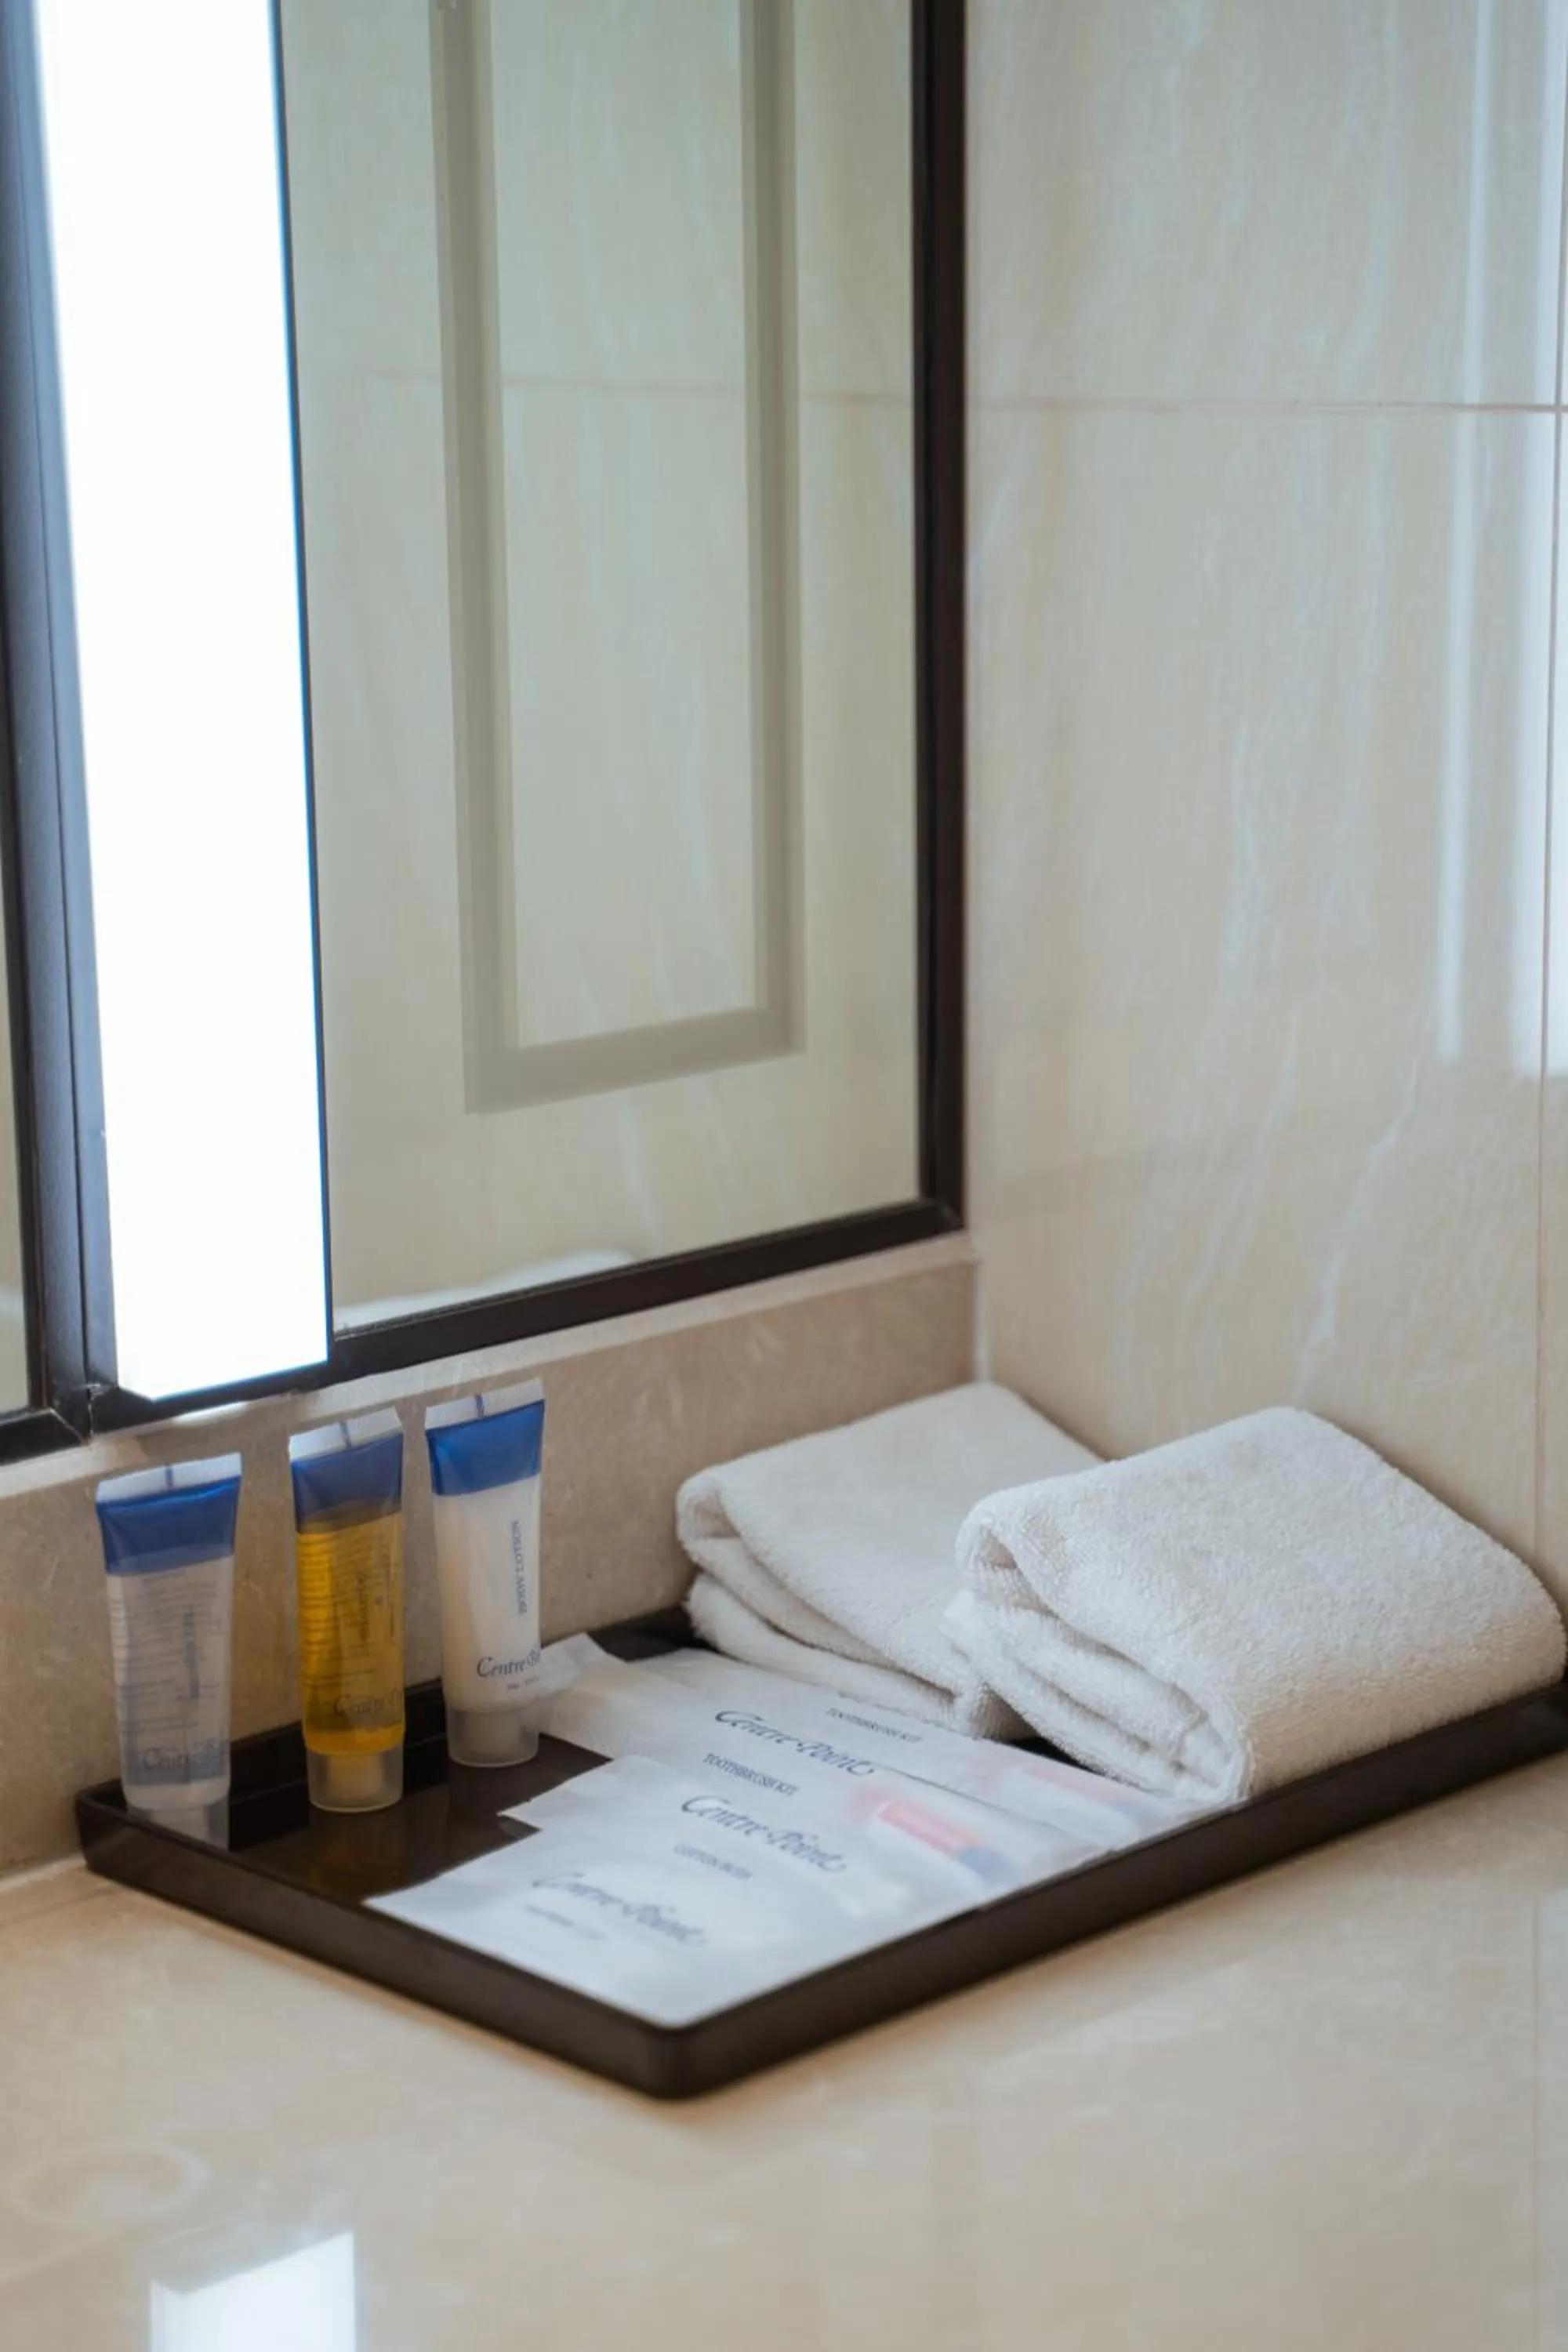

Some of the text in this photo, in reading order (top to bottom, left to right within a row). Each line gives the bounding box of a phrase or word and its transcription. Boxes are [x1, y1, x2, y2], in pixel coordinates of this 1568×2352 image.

[511, 1520, 528, 1614] BODY LOTION
[477, 1656, 526, 1678] Centre
[702, 1752, 799, 1797] TOOTHBRUSH KIT
[714, 1710, 875, 1776] Centre Point
[681, 1795, 847, 1874] Centre Point
